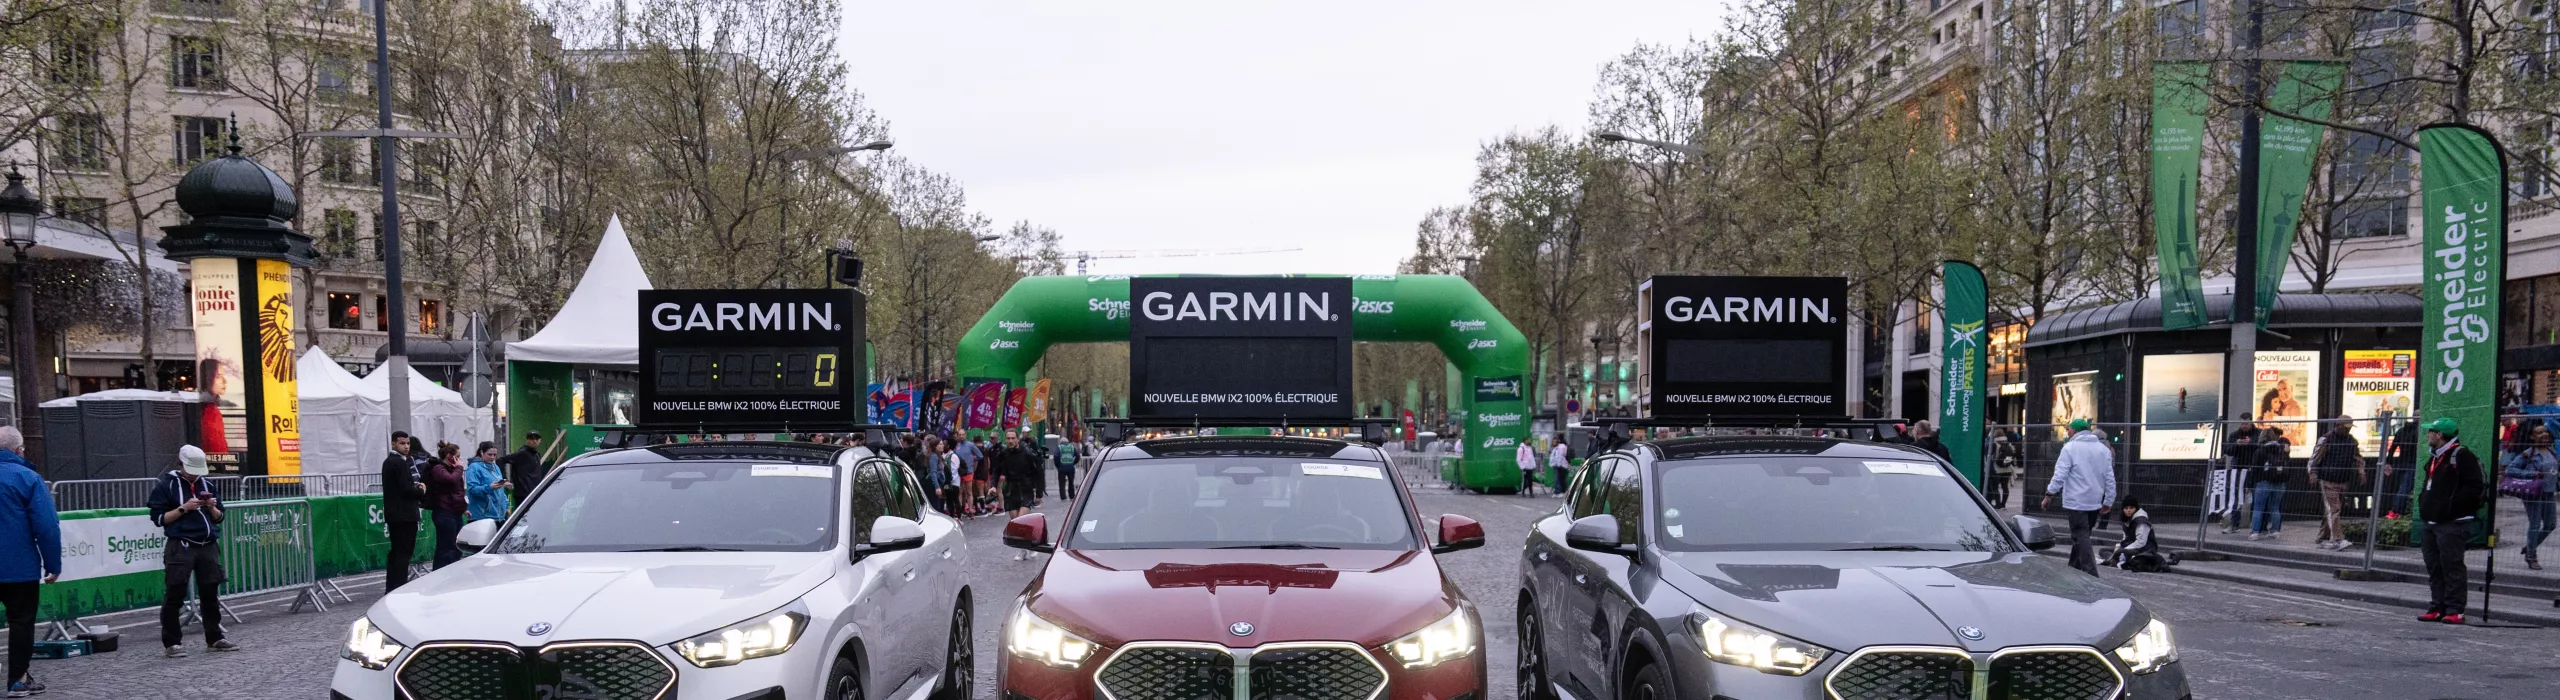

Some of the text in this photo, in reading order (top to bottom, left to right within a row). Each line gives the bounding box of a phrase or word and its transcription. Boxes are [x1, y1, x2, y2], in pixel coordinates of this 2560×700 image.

[2467, 201, 2488, 309] Electric
[1088, 297, 1131, 311] Schne
[1142, 291, 1329, 321] GARMIN
[2435, 205, 2468, 395] Schneider
[1358, 300, 1395, 314] asics
[1664, 296, 1829, 323] GARMIN
[651, 302, 833, 332] GARMIN
[1450, 319, 1487, 328] Schneider
[998, 320, 1035, 328] Schneider
[999, 340, 1019, 348] asics
[1477, 340, 1497, 348] asics
[1963, 347, 1975, 390] PARIS
[2257, 370, 2278, 381] Gala
[1946, 357, 1958, 416] Schneider
[2346, 380, 2410, 392] IMMOBILIER
[1144, 391, 1338, 404] NOUVELLE BMW iX2 100% ÉLECTRIQUE
[1666, 394, 1713, 403] NOUVELLE
[1714, 394, 1737, 403] BMW
[1752, 395, 1776, 403] 100%
[1777, 393, 1832, 404] ÉLECTRIQUE
[653, 399, 841, 411] NOUVELLE BMW iX2 100% ÉLECTRIQUE
[1962, 389, 1970, 432] MARATHON
[1479, 412, 1522, 423] Schneider
[1493, 437, 1516, 446] asics
[107, 532, 167, 553] Schneider
